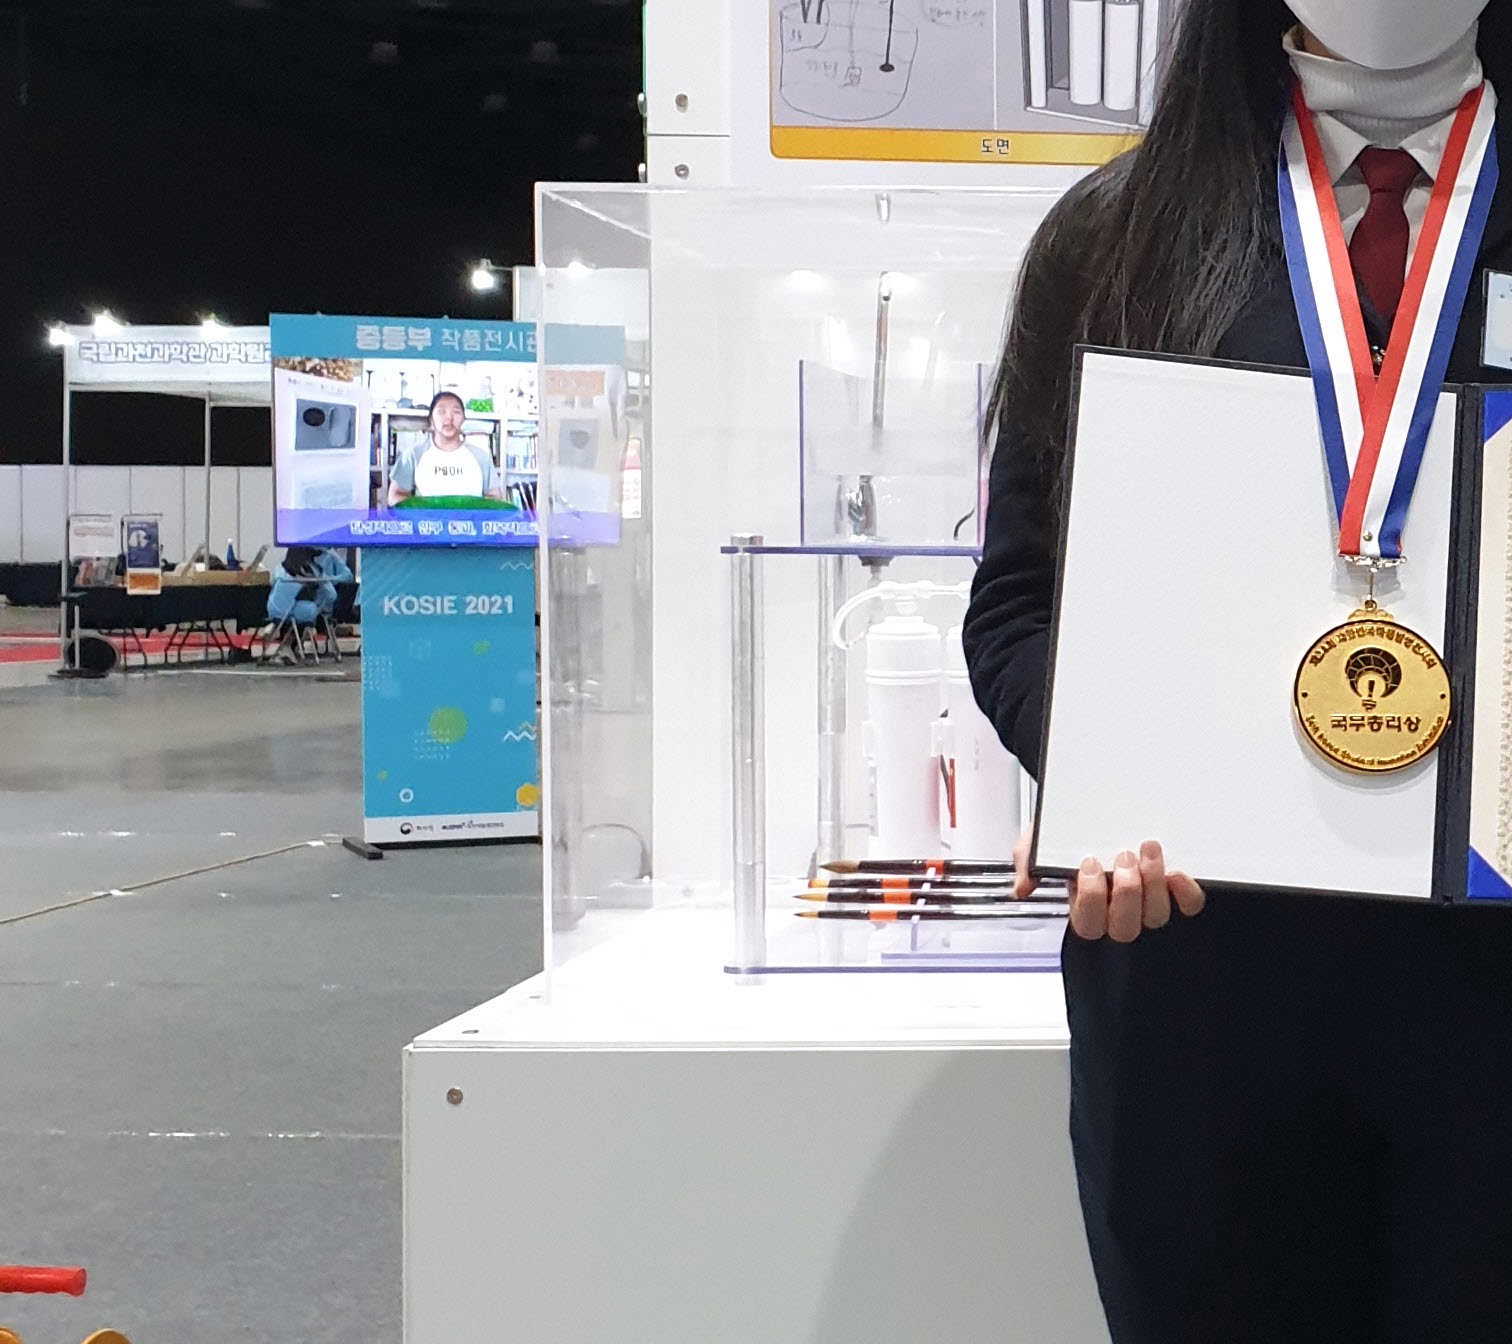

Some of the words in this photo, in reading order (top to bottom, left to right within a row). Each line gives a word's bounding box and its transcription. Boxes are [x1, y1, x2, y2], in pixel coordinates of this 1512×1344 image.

[981, 138, 1009, 154] 도면
[383, 594, 458, 616] KOSIE
[464, 594, 514, 616] 2021
[1331, 714, 1422, 733] 국무총리상
